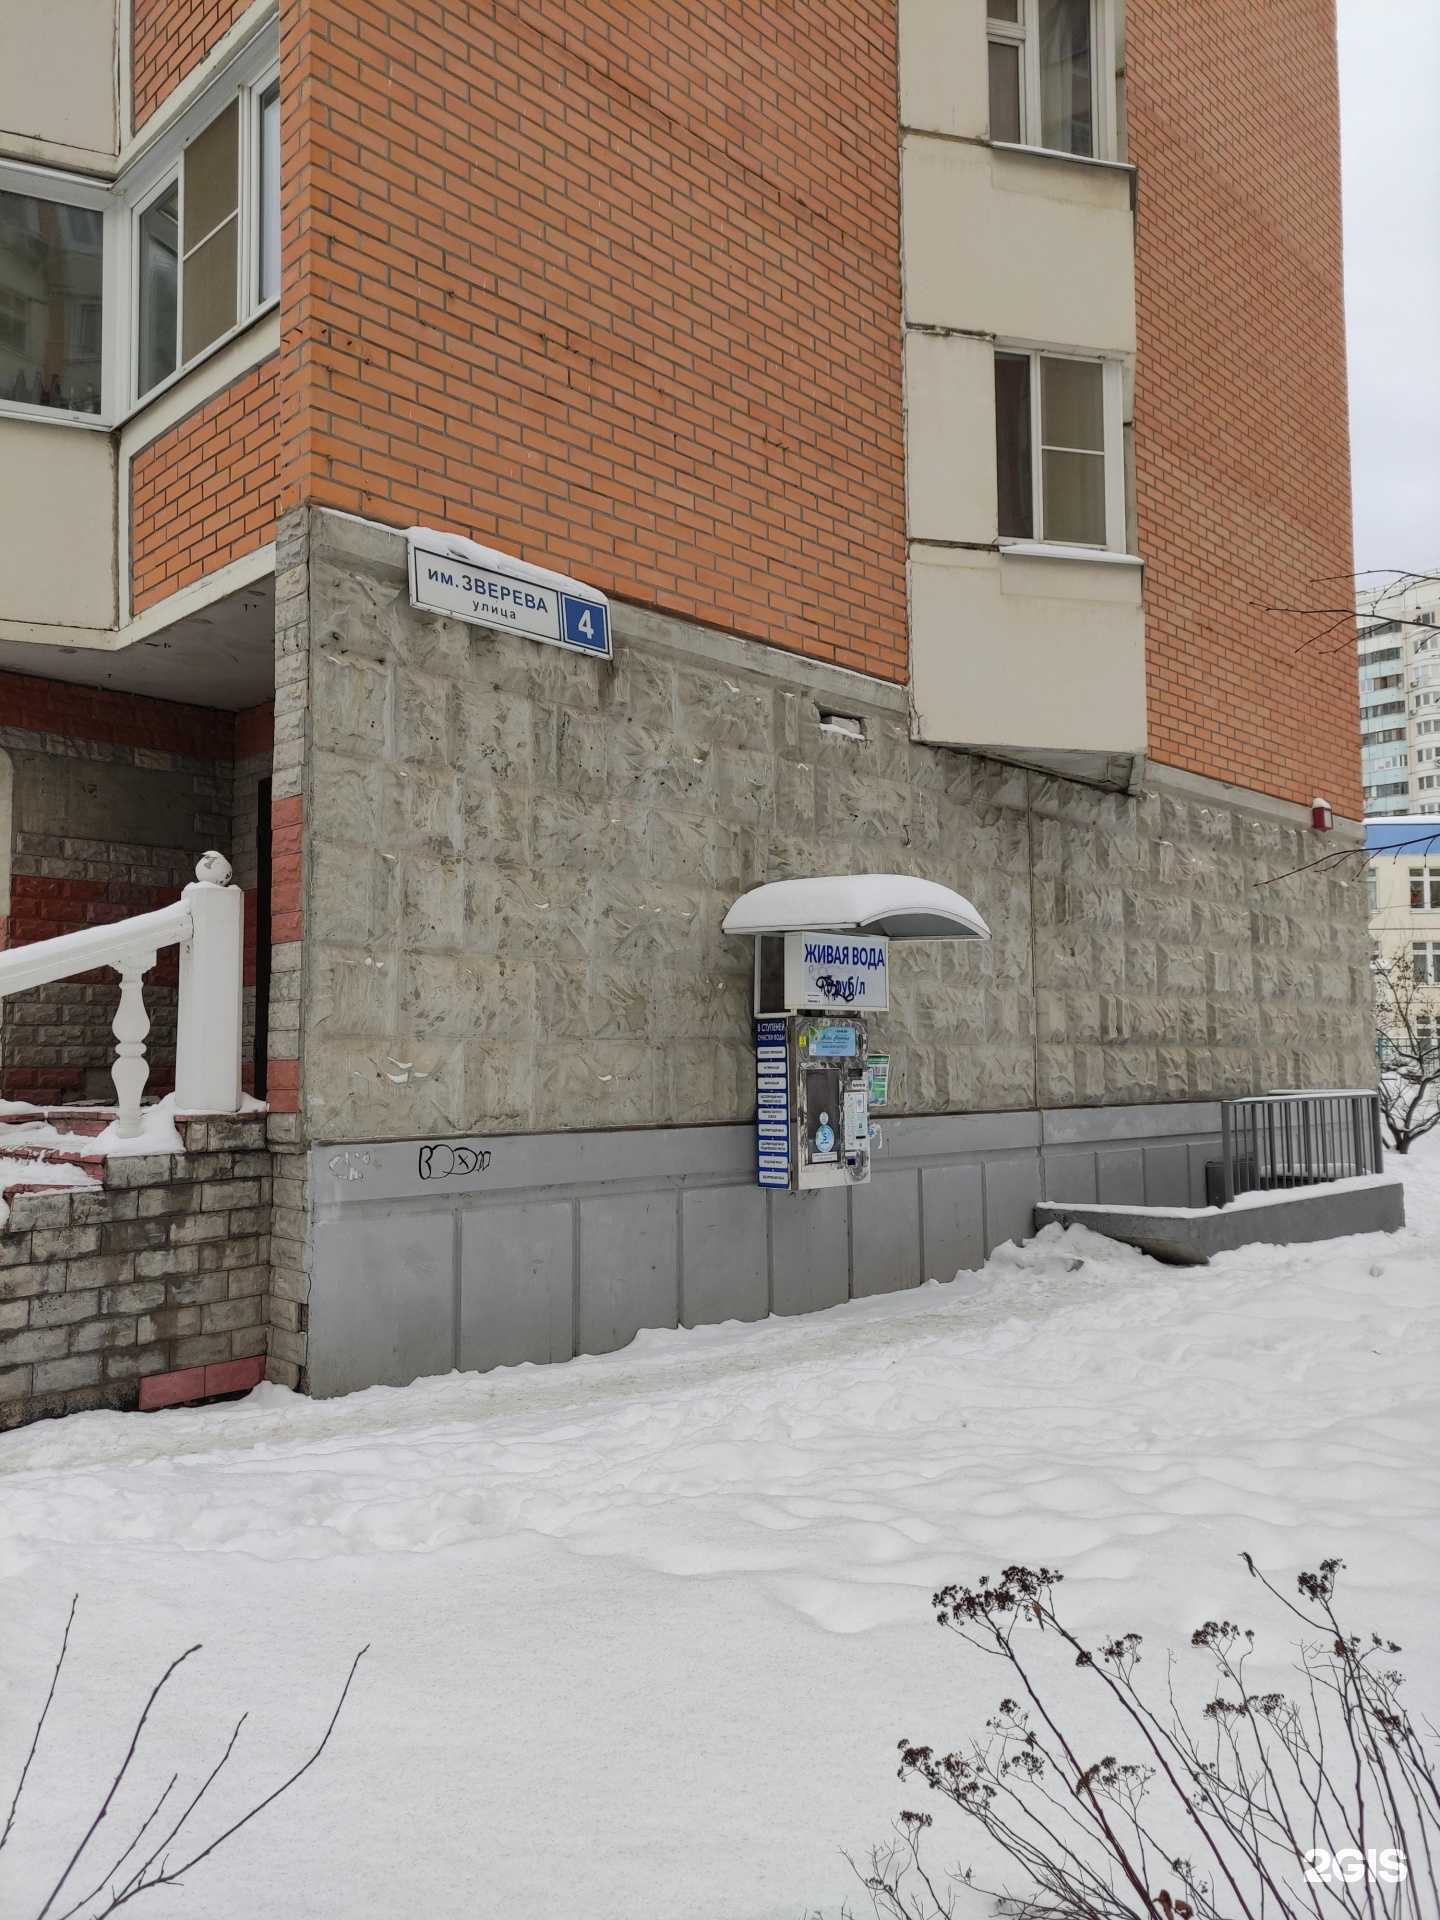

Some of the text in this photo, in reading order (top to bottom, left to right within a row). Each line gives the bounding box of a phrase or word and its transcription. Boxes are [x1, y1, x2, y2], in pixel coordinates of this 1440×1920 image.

[462, 574, 548, 614] ЗВЕРЕВА
[472, 599, 517, 620] улица
[577, 608, 595, 640] 4
[804, 943, 885, 971] ЖИВАЯ ВОДА
